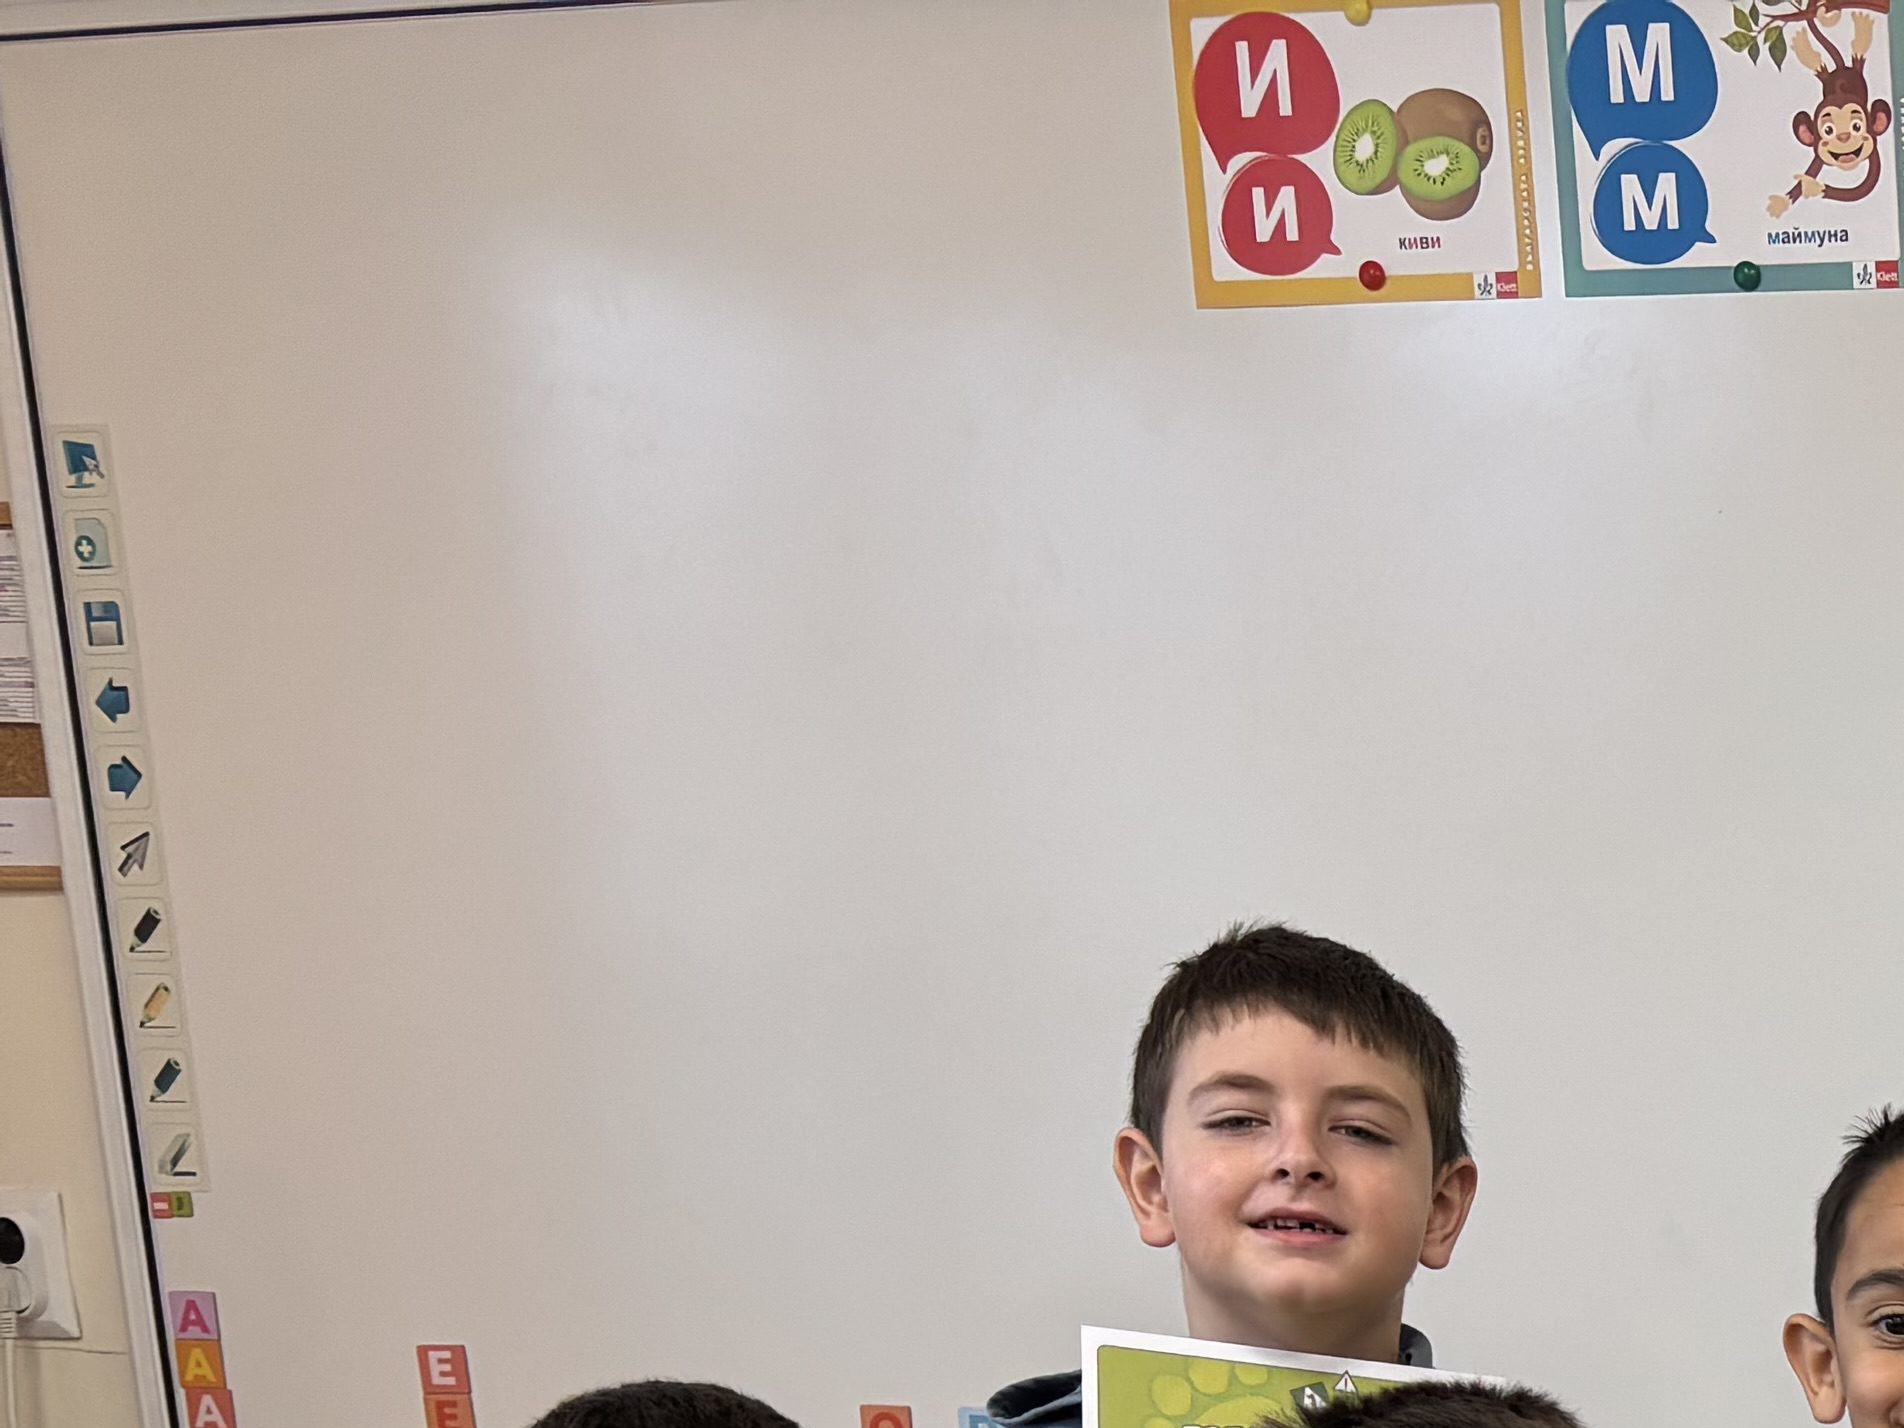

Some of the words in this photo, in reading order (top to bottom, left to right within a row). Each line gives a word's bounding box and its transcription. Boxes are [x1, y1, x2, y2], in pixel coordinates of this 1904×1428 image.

[1235, 39, 1292, 118] И
[1606, 23, 1674, 103] М
[1399, 235, 1441, 250] киви
[1767, 226, 1849, 247] маймуна
[1876, 271, 1898, 282] Klett
[178, 1300, 209, 1333] А
[184, 1349, 215, 1382] А
[195, 1394, 226, 1428] А
